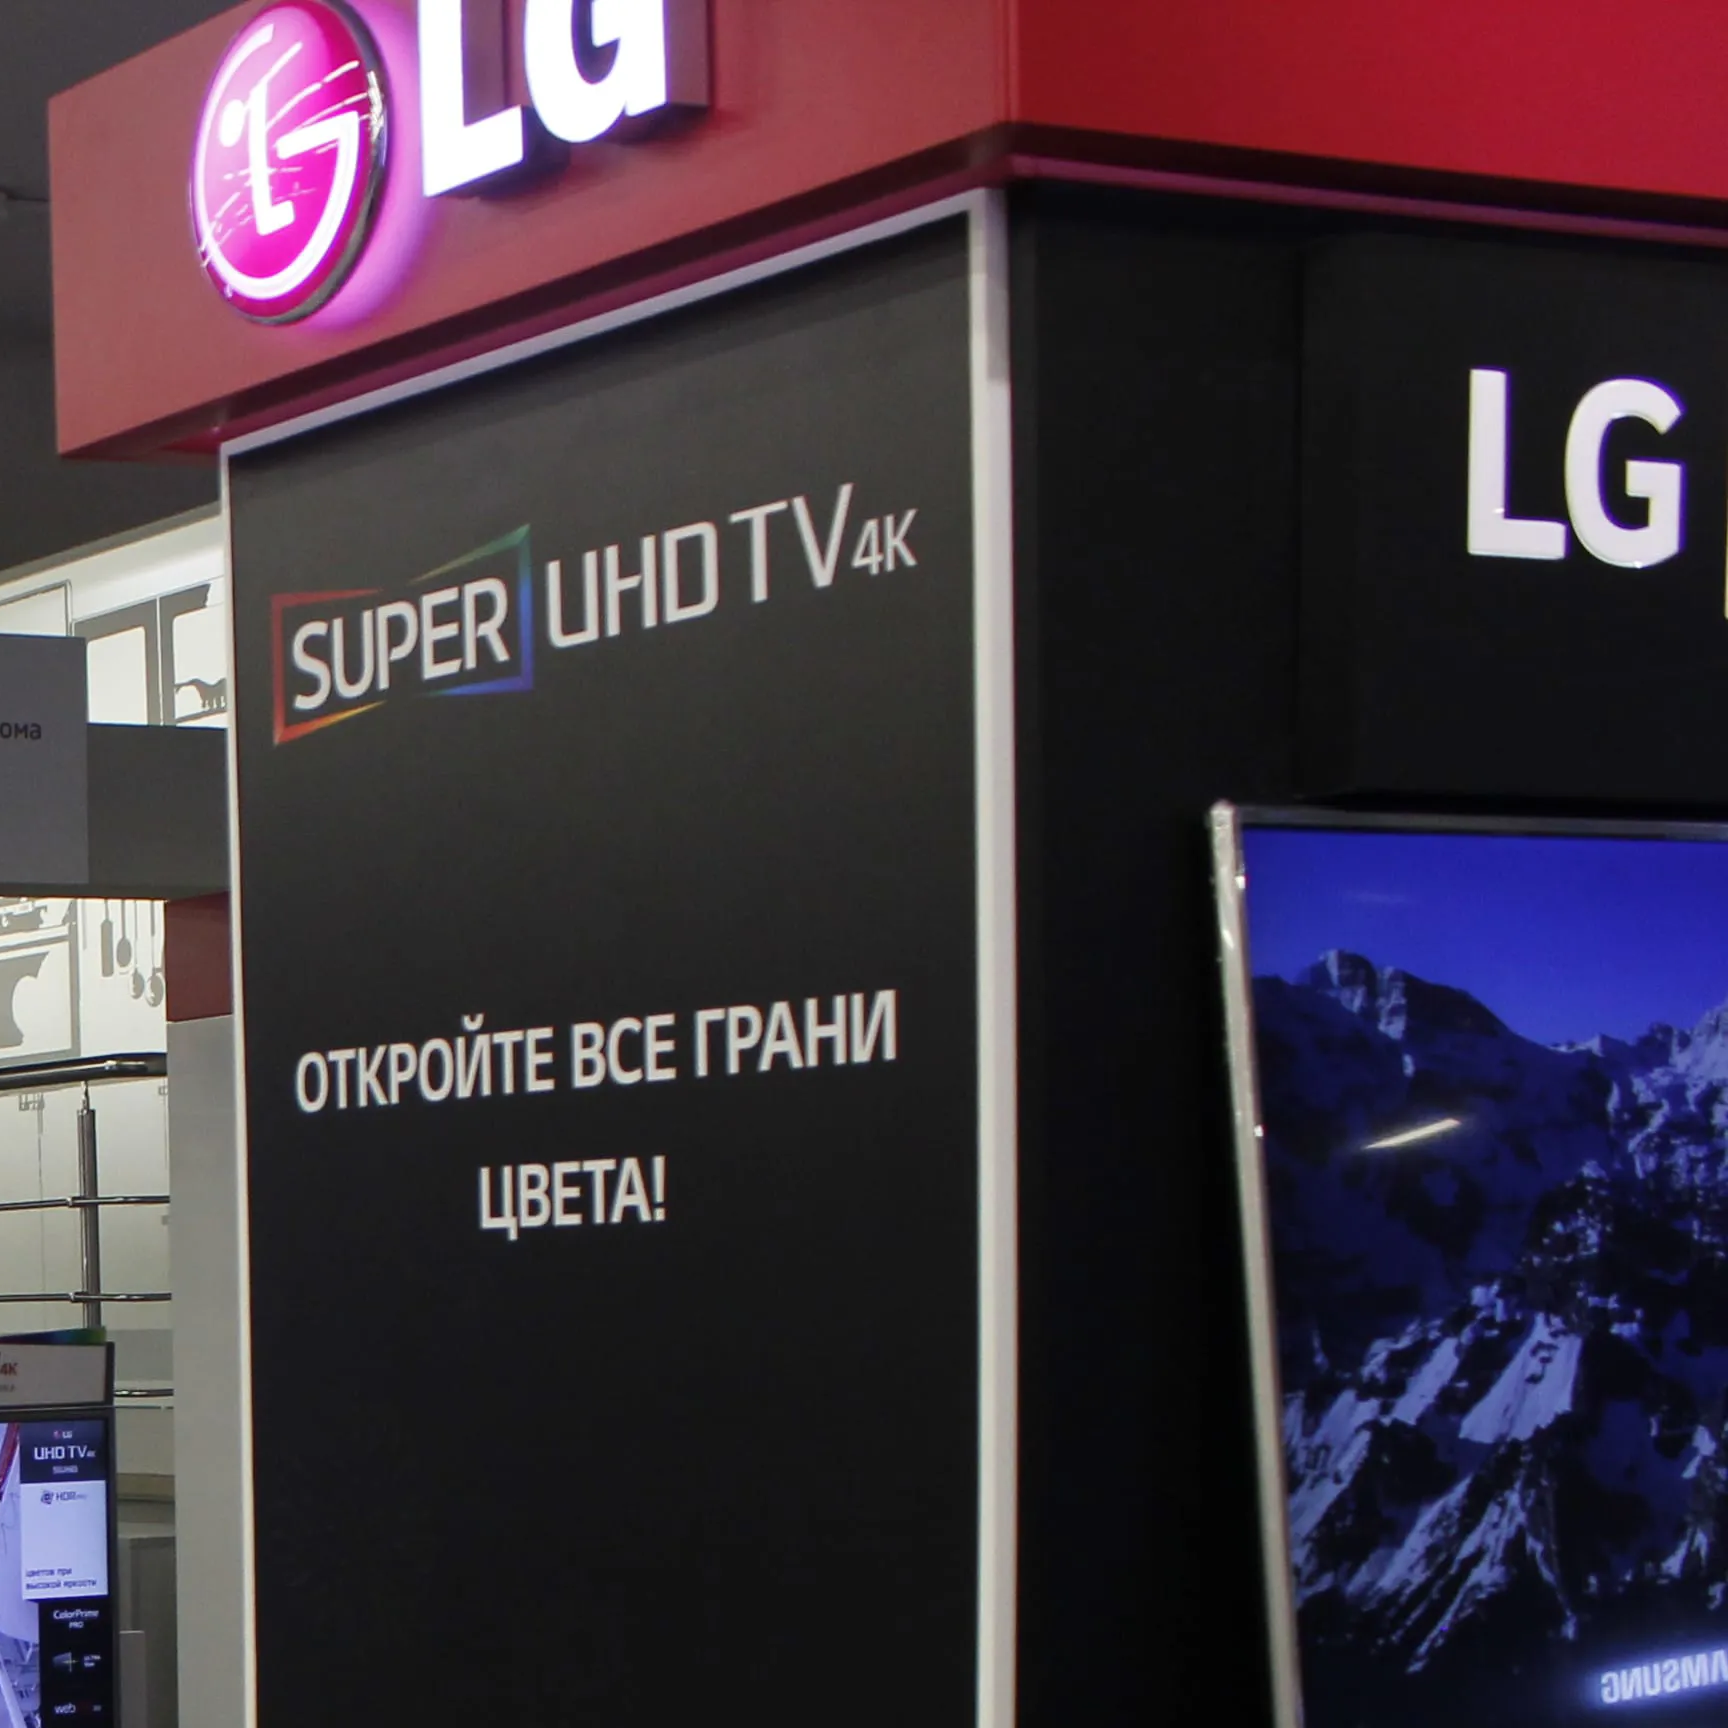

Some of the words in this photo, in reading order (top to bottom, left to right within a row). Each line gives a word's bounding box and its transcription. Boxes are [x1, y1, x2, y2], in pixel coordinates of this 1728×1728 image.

[418, 0, 667, 197] LG
[1467, 367, 1685, 569] LG
[291, 574, 511, 711] SUPER
[546, 519, 720, 649] UHD
[295, 1013, 555, 1113] ОТКРОЙТЕ
[571, 1014, 676, 1090] ВСЕ
[694, 988, 898, 1078] ГРАНИ
[478, 1155, 667, 1241] ЦВЕТА!
[34, 1445, 65, 1460] UHD
